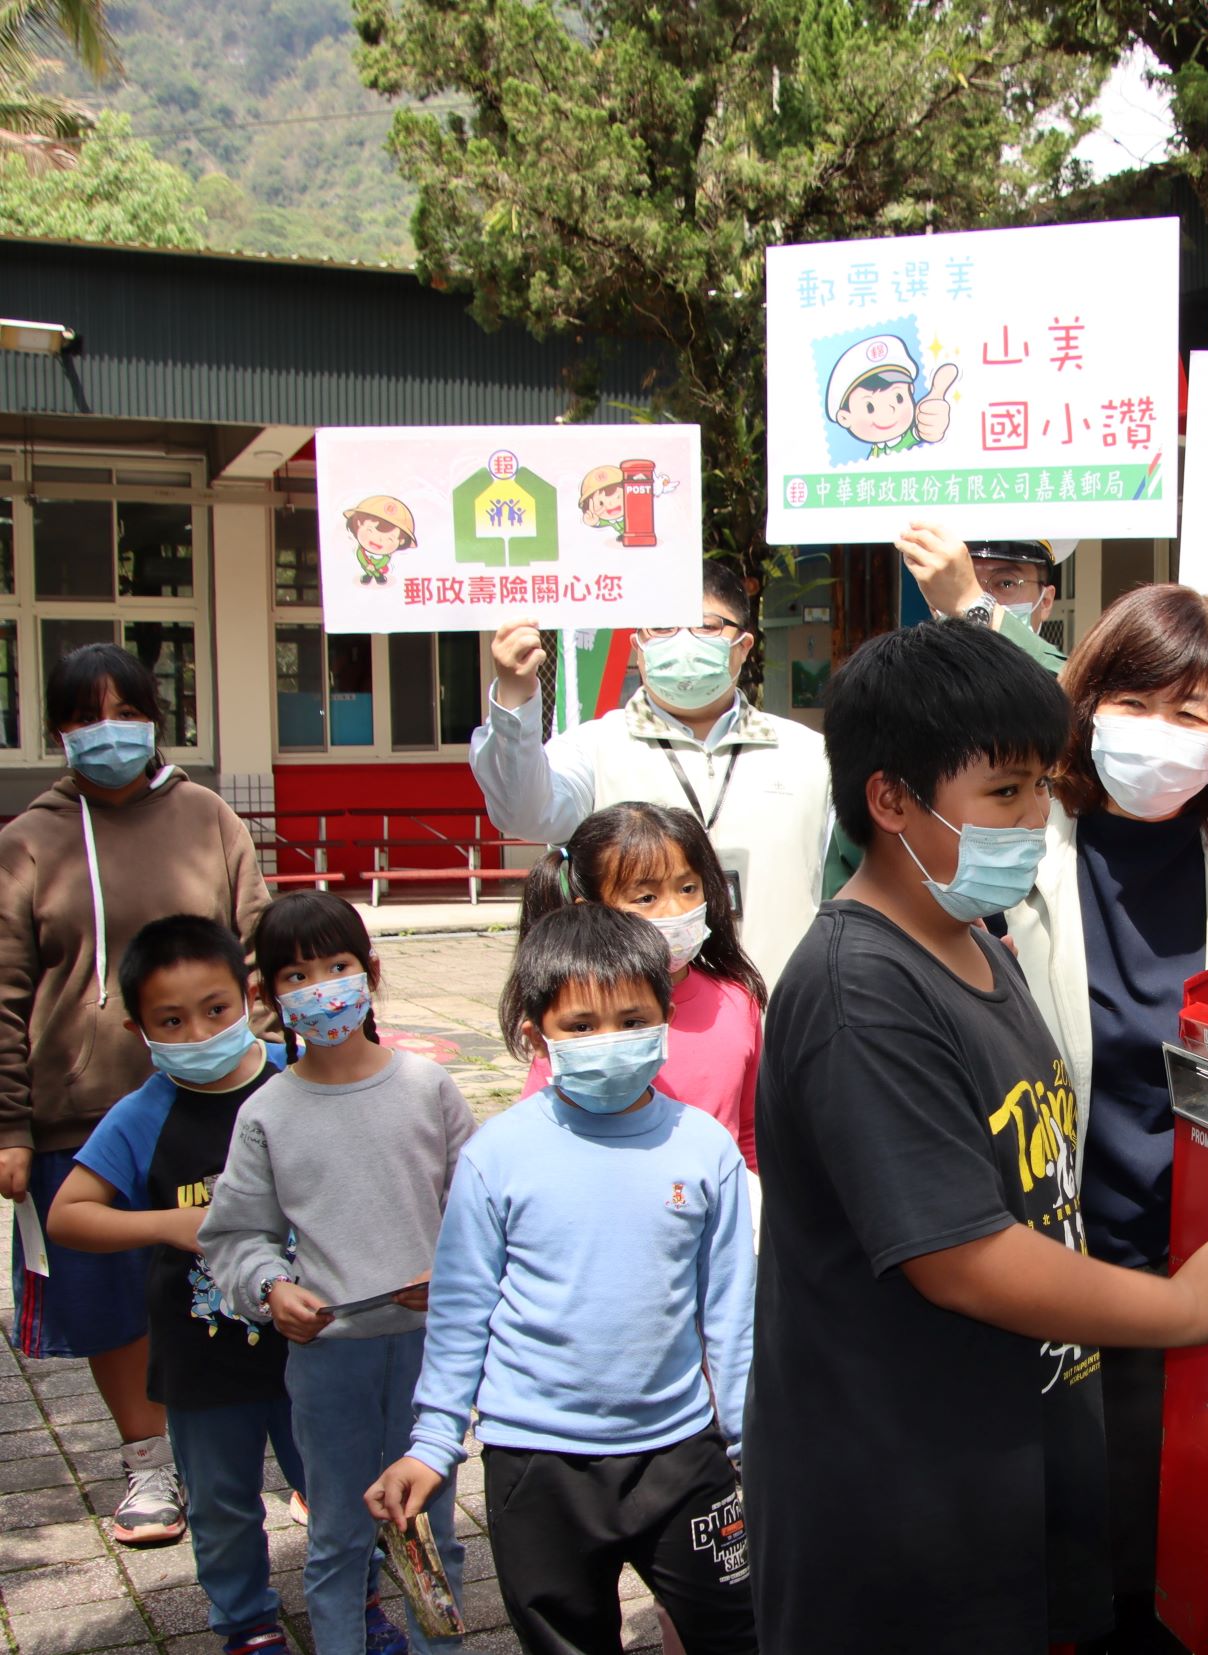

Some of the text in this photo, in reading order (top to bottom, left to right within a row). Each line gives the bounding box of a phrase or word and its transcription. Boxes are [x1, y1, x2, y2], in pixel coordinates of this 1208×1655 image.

[796, 256, 975, 308] 郵票選美
[982, 316, 1085, 372] 山美
[981, 395, 1157, 451] 國小讚
[626, 485, 651, 495] POST
[815, 469, 1124, 506] 中華郵政股份有限公司嘉義郵局
[403, 573, 624, 606] 郵政壽險關心您
